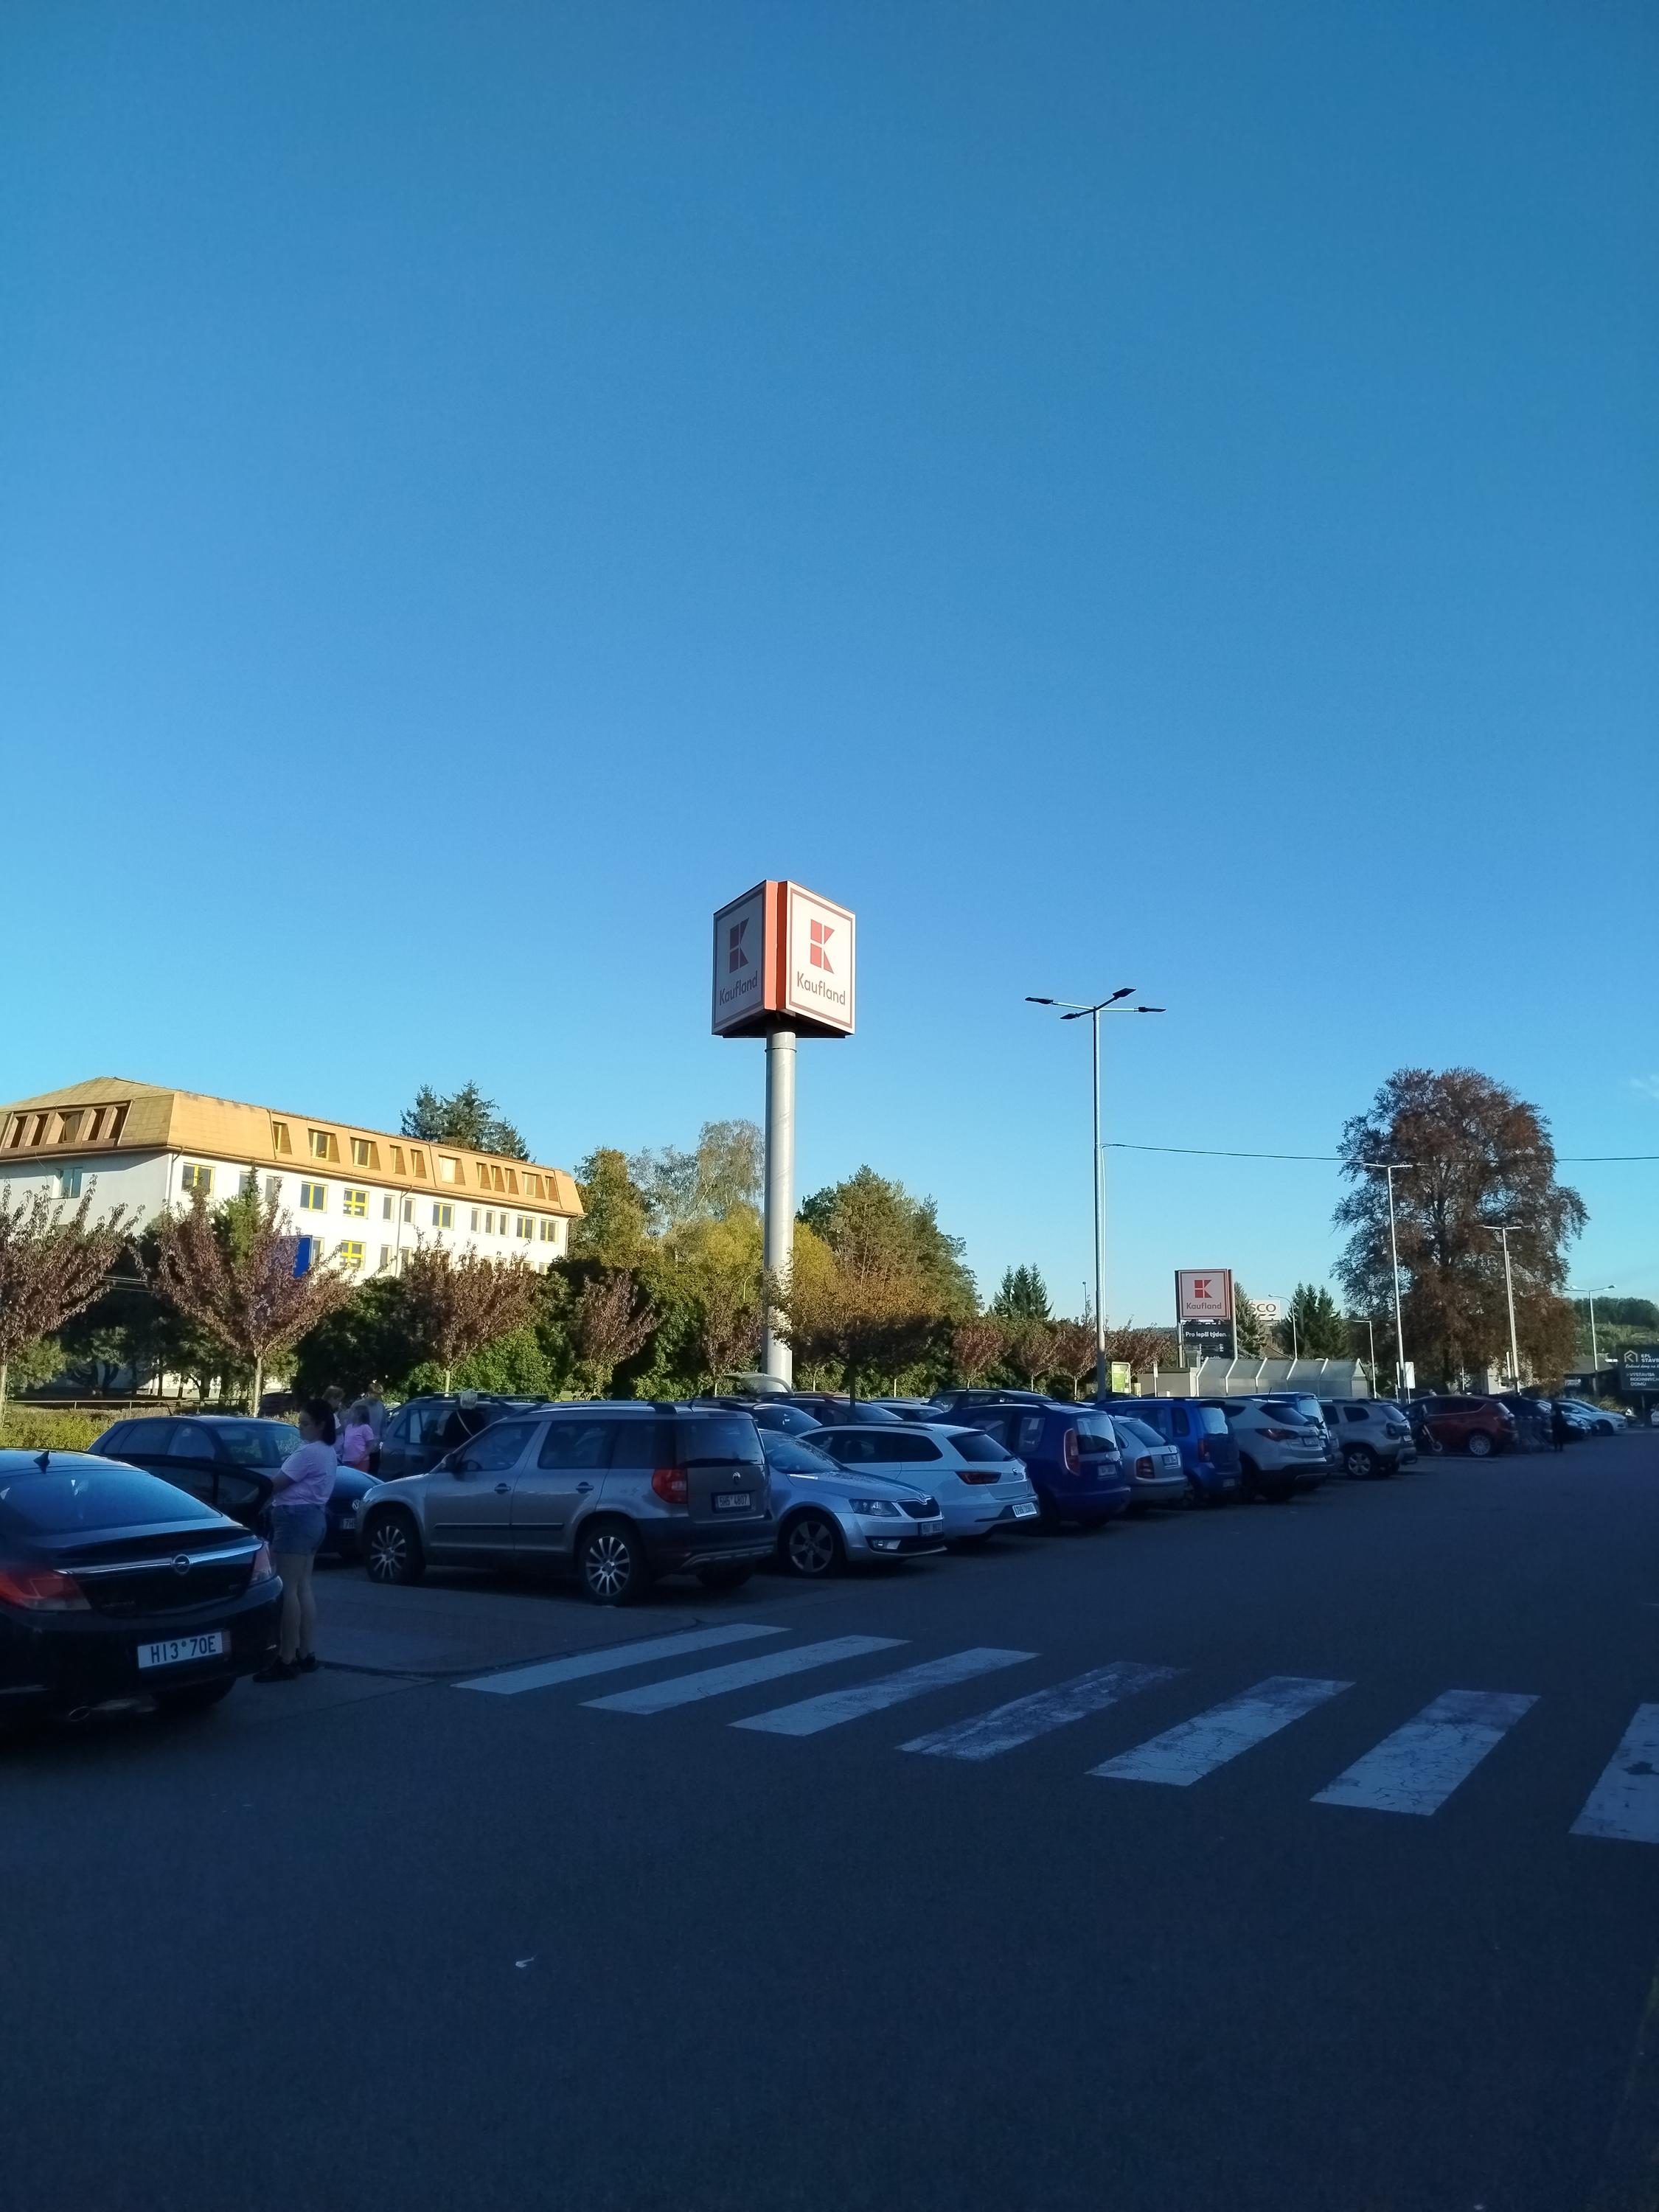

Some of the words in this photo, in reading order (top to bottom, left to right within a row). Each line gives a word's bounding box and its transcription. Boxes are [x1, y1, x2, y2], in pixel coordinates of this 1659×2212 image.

[810, 919, 835, 974] K
[719, 970, 758, 1006] Kaufland
[797, 971, 846, 1006] Kaufland
